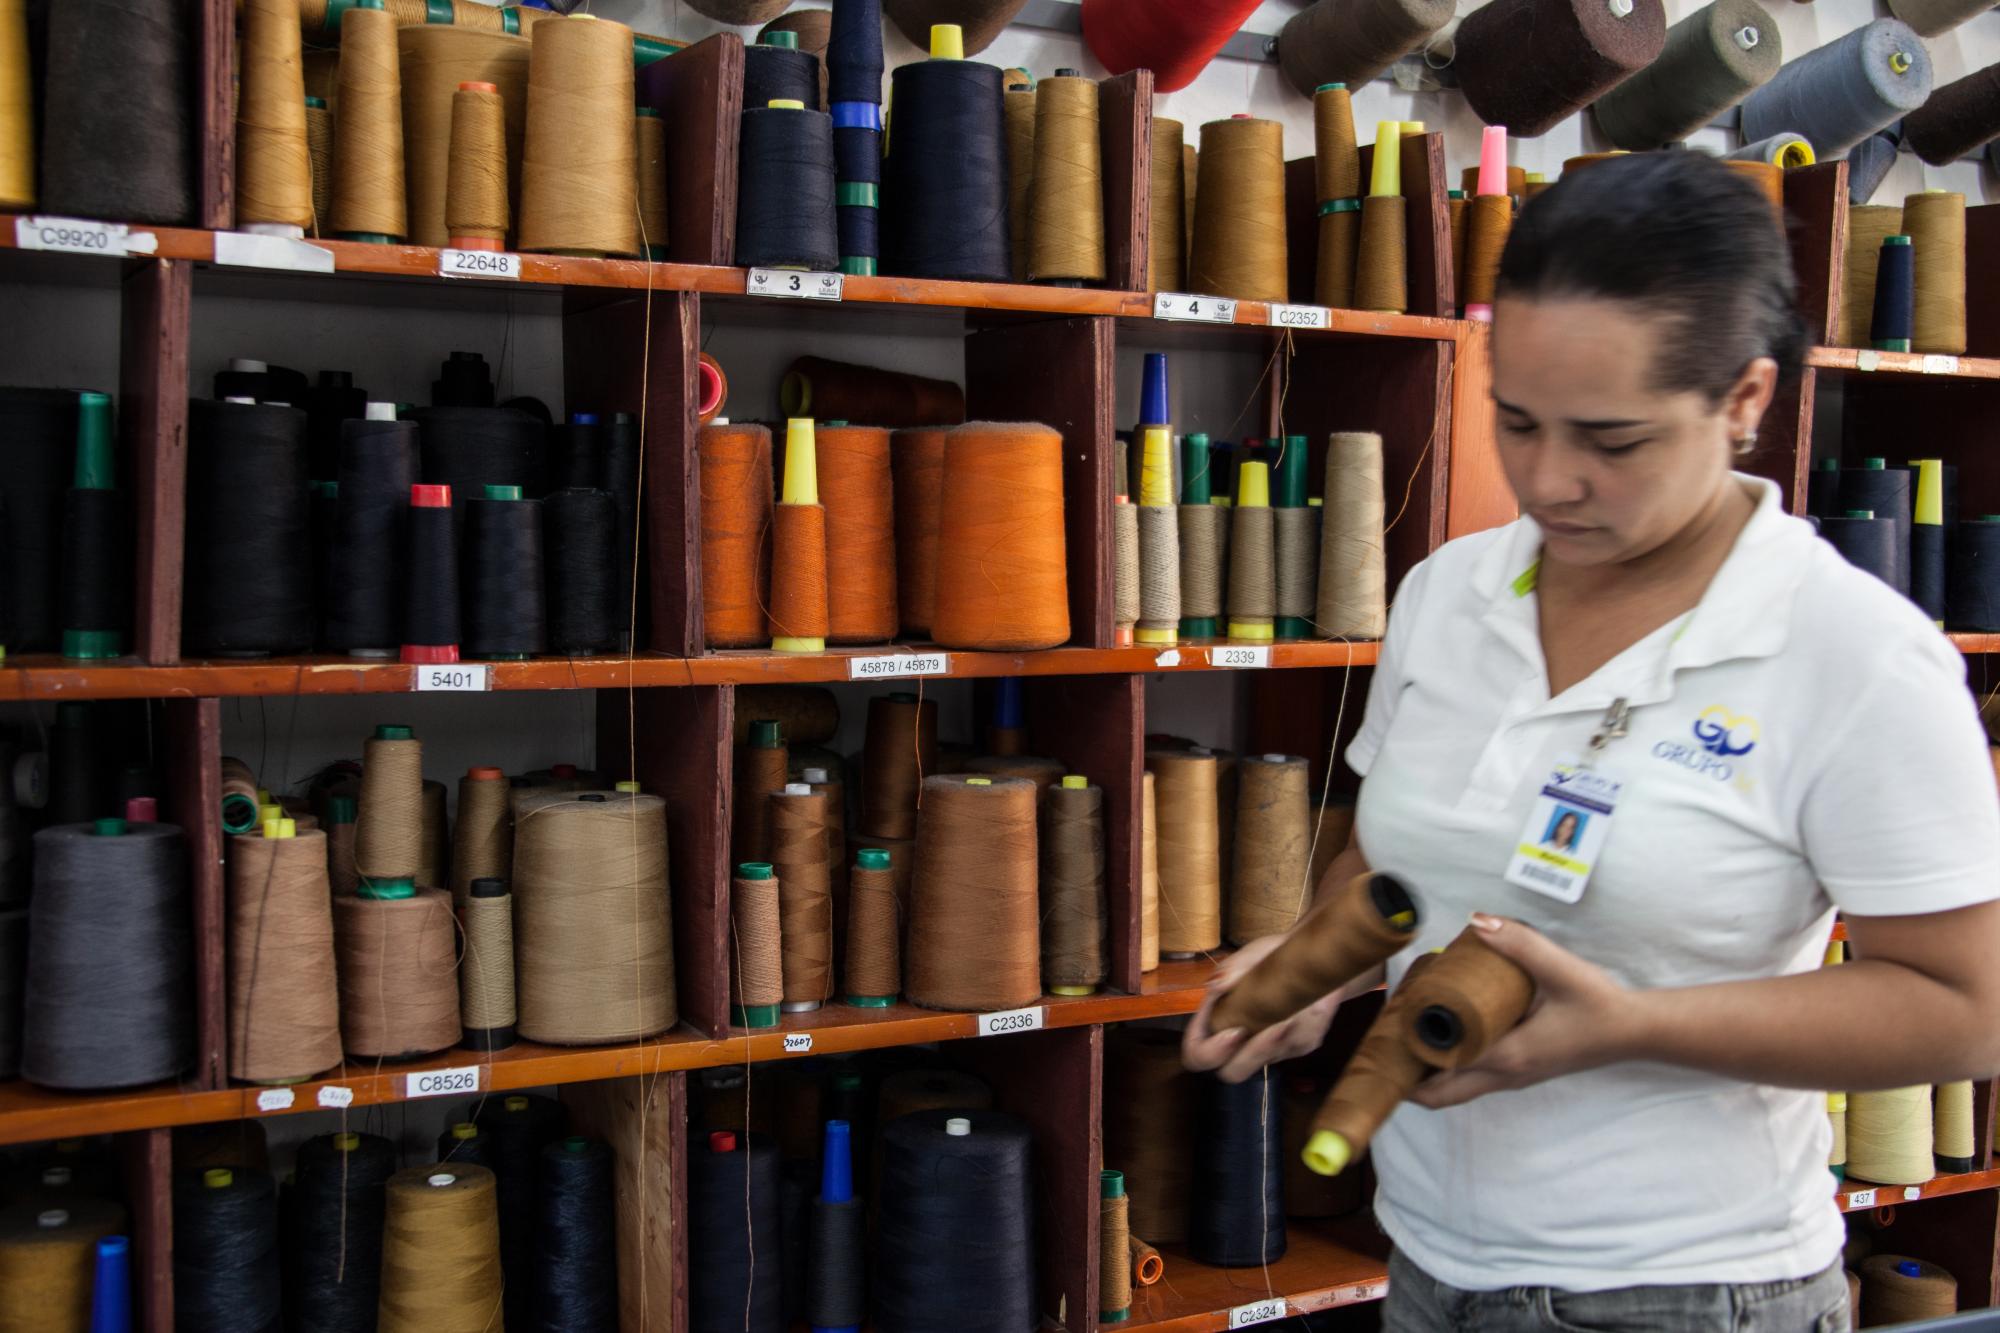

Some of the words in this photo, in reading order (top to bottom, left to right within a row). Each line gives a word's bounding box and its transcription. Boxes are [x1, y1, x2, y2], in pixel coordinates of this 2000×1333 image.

[40, 227, 108, 249] C9920
[456, 253, 509, 272] 22648
[789, 275, 801, 291] 3
[1189, 301, 1199, 315] 4
[1280, 311, 1318, 325] C2352
[1225, 650, 1255, 664] 2339
[860, 661, 895, 674] 45878
[905, 659, 939, 671] 45879
[432, 672, 472, 687] 5401
[1651, 740, 1734, 782] GRUPO
[990, 1013, 1033, 1031] C2336
[784, 1037, 811, 1047] 32607
[419, 1073, 474, 1092] C8526
[1855, 1193, 1870, 1204] 437
